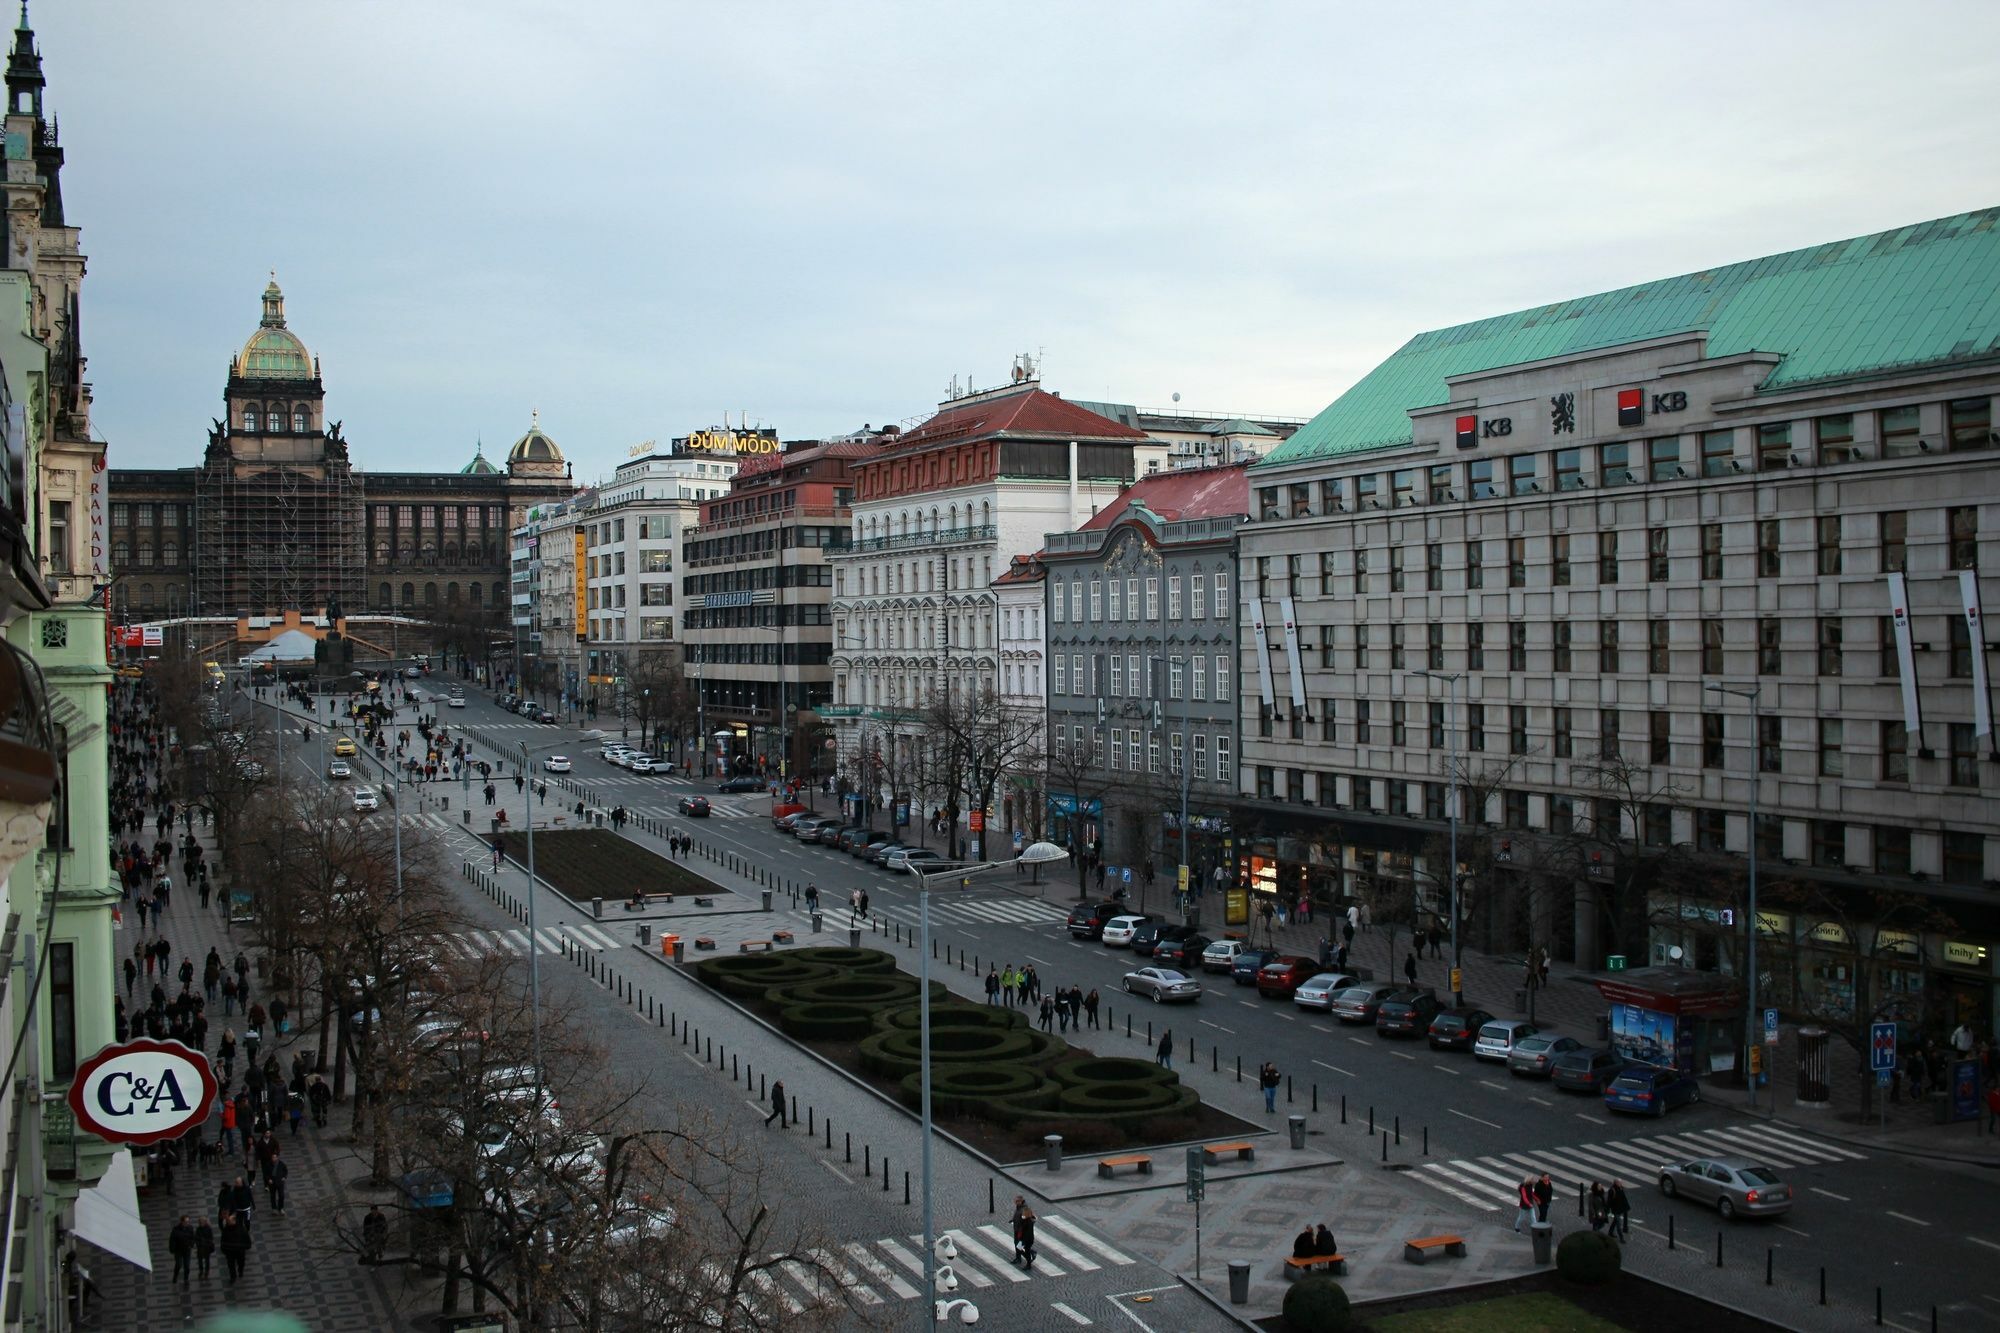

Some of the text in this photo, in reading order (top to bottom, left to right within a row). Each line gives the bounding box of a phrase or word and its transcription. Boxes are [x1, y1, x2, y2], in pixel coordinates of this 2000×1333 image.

[1651, 391, 1687, 414] KB
[1482, 418, 1512, 438] KB
[689, 430, 728, 450] DŮM
[91, 483, 102, 574] RAMADA
[577, 568, 585, 628] FASHION
[1757, 917, 1778, 927] books
[1949, 946, 1974, 959] knihy
[97, 1070, 191, 1116] C&A
